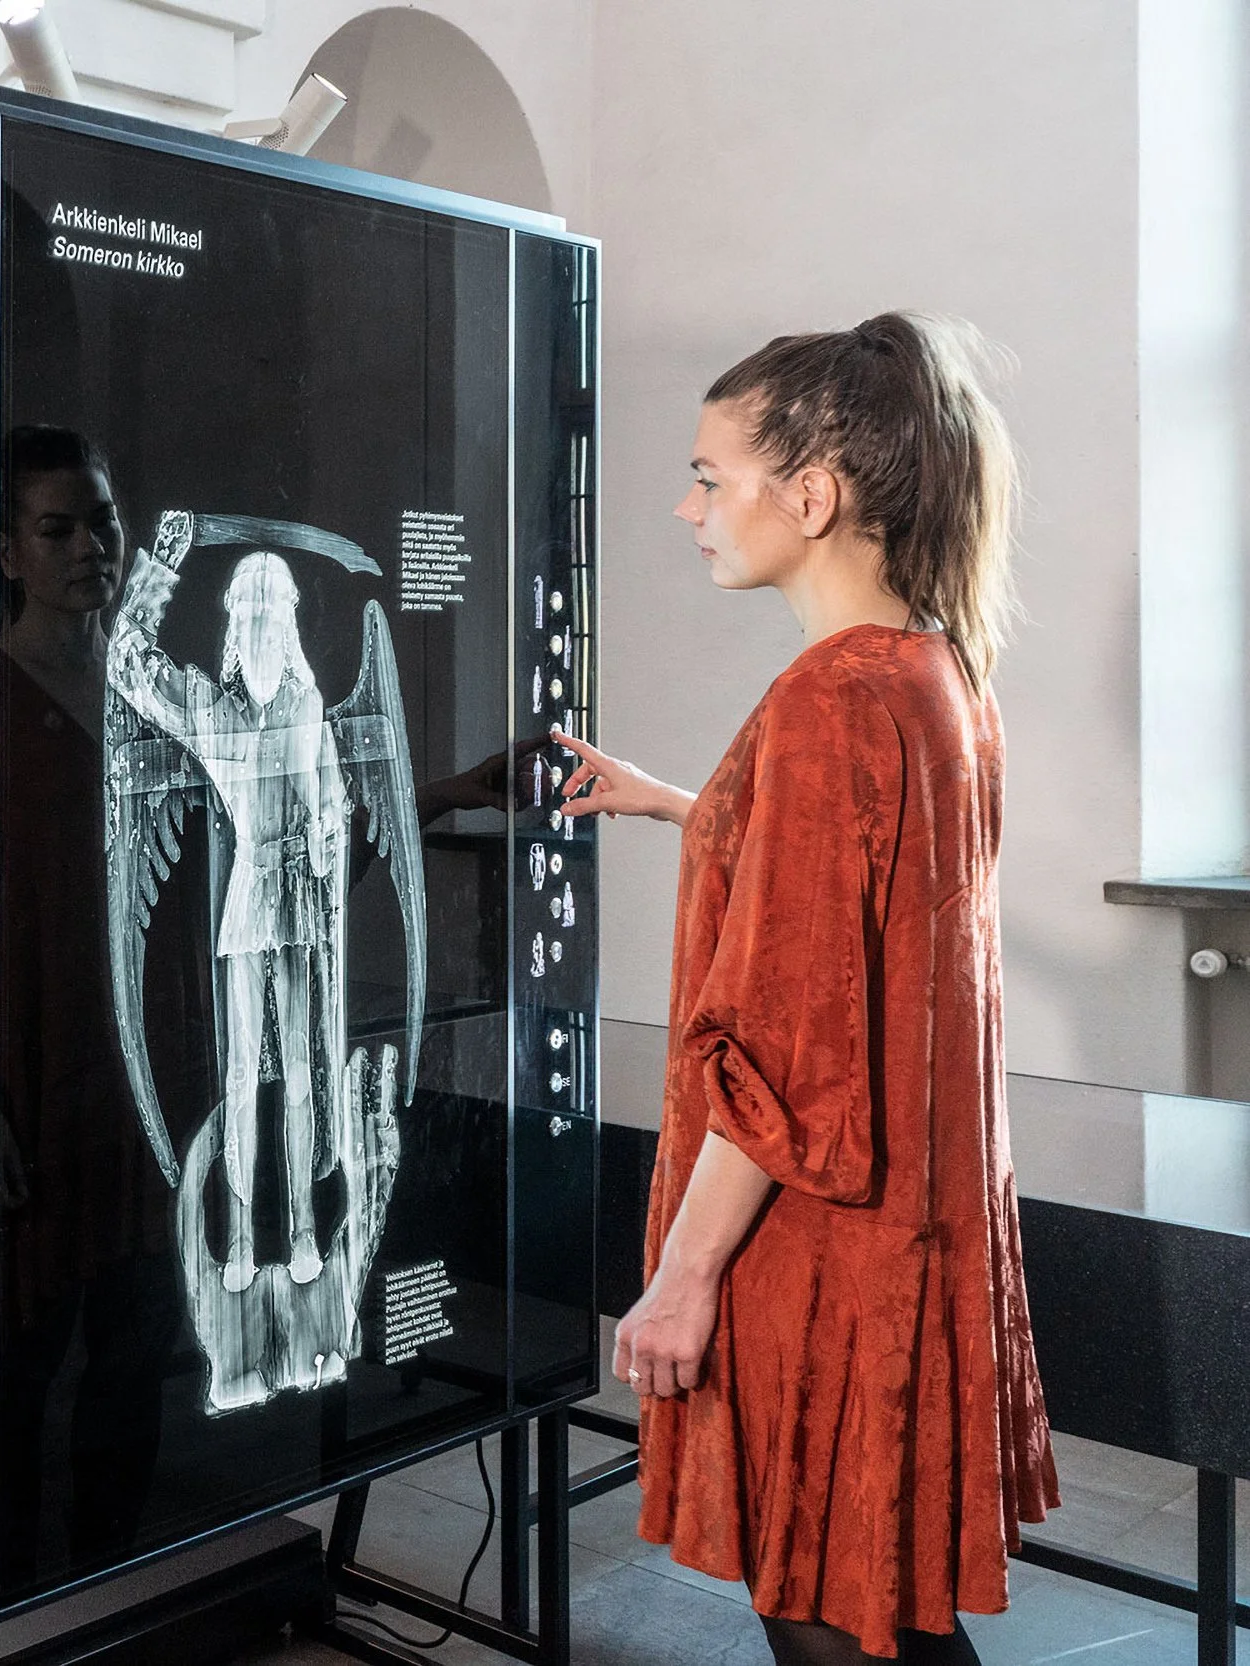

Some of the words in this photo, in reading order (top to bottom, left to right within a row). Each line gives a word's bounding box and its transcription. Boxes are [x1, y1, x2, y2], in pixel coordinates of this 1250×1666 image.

[52, 202, 146, 239] Arkkienkeli
[150, 221, 203, 250] Mikael
[53, 235, 133, 269] Someron
[136, 250, 185, 278] kirkko
